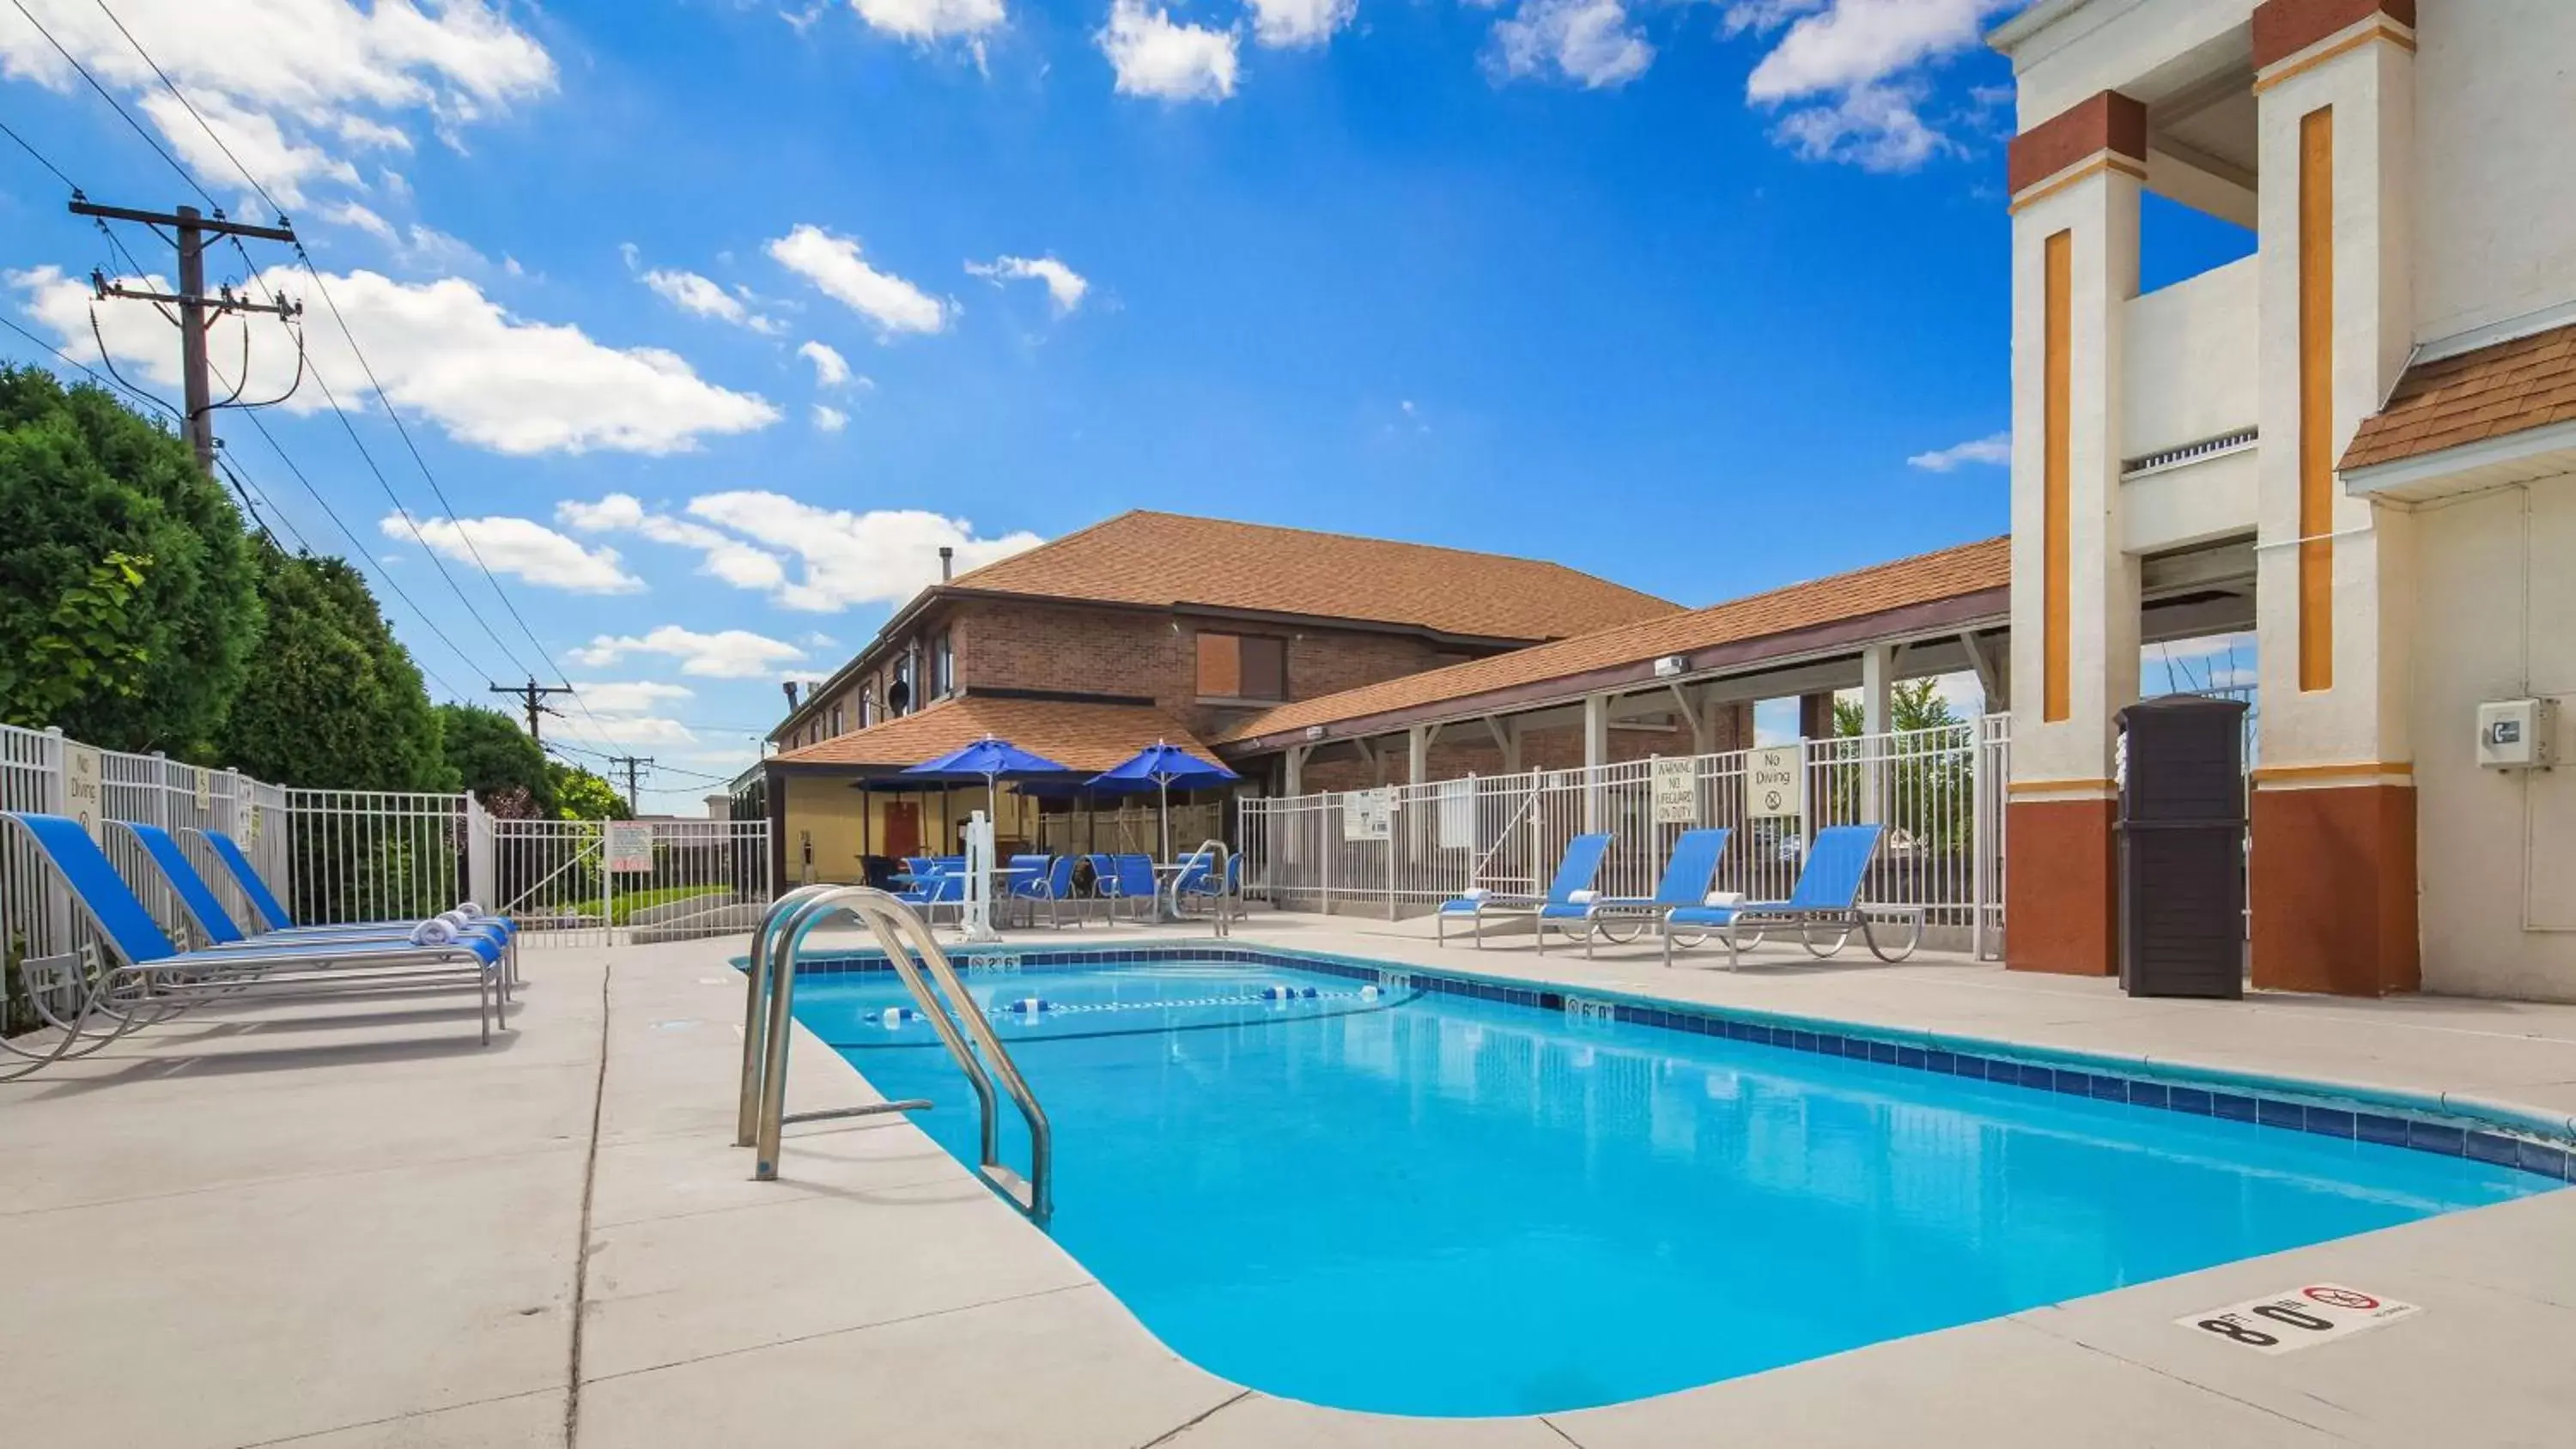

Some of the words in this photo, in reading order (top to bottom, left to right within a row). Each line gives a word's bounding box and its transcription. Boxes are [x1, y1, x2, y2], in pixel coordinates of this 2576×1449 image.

[1765, 753, 1781, 767] No
[1657, 761, 1693, 776] WARNING
[1755, 768, 1790, 785] Diving
[1668, 777, 1680, 790] NO
[1656, 791, 1694, 804] LIFEGUARD
[1658, 807, 1671, 819] ON
[1672, 806, 1692, 818] DUTY
